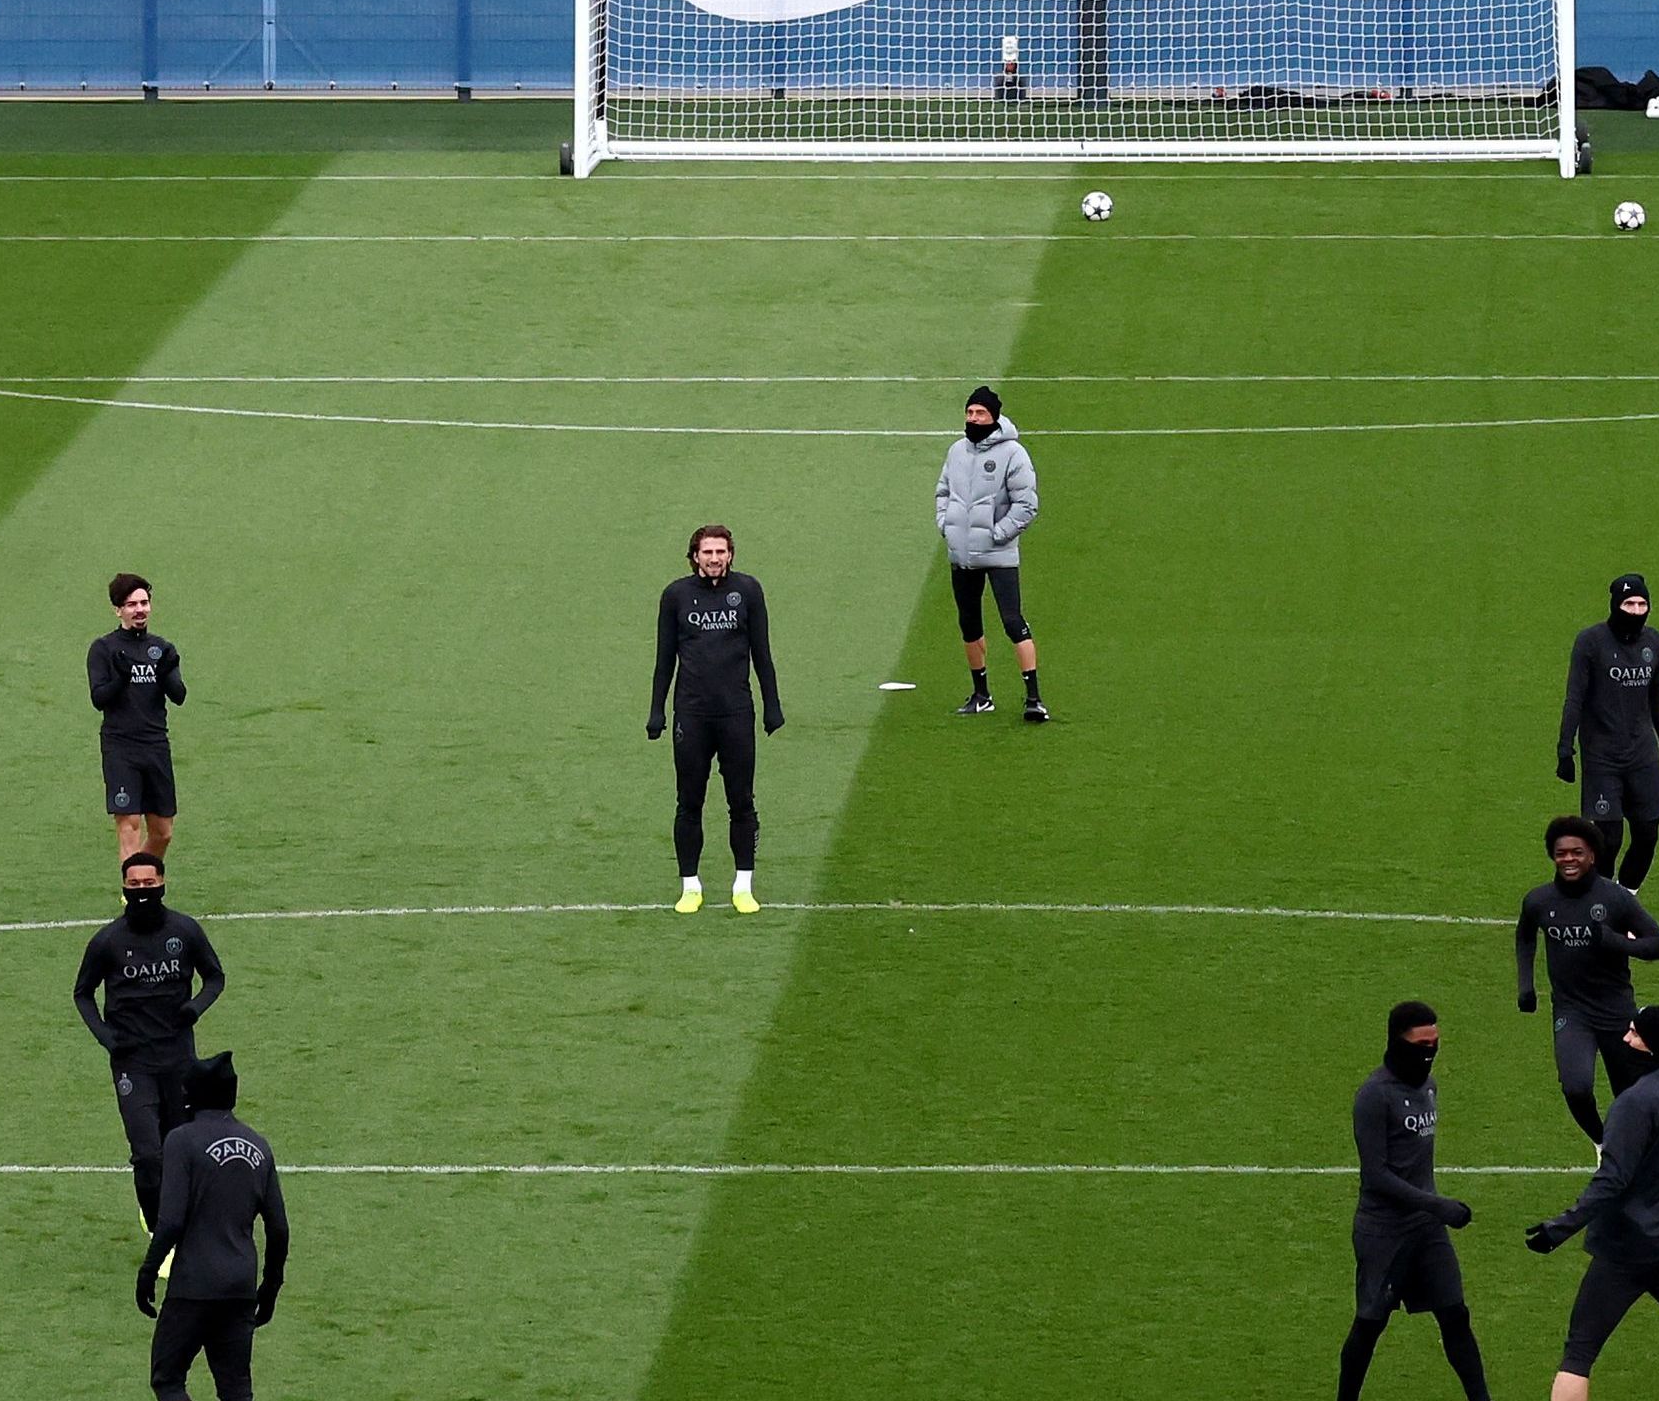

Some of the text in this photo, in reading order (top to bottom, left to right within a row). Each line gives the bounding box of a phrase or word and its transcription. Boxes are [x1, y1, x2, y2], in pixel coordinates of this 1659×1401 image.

[688, 610, 737, 625] QATAR
[700, 621, 739, 631] AIRWAYS
[1609, 666, 1653, 681] QATAR
[1548, 926, 1592, 940] QATA
[209, 1140, 265, 1167] PARIS
